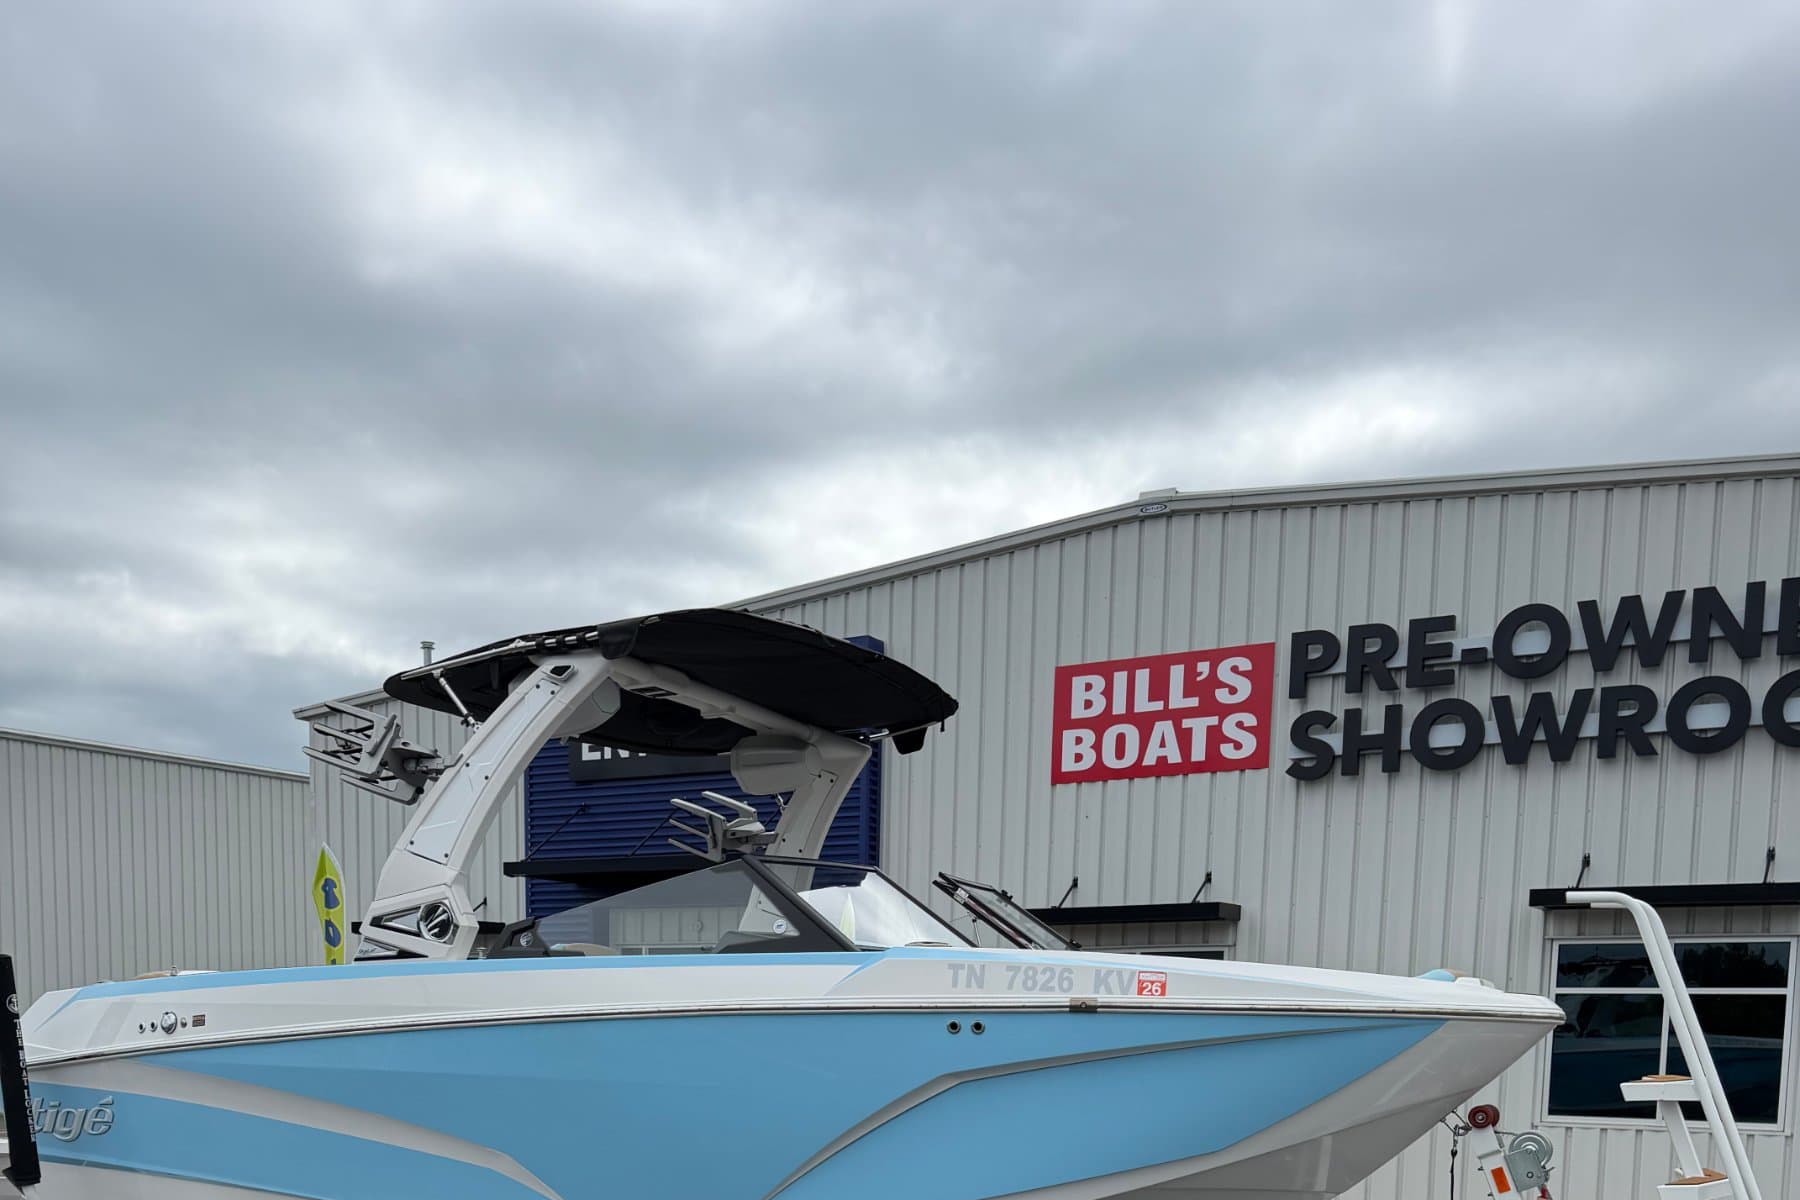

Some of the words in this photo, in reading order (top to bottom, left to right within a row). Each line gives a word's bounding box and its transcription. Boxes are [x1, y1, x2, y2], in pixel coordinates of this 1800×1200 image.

[1071, 656, 1253, 720] BILL'S
[1060, 712, 1258, 773] BOATS
[947, 963, 986, 989] TN
[1005, 965, 1074, 993] 7826
[1093, 969, 1136, 996] KV
[1142, 982, 1162, 996] 26
